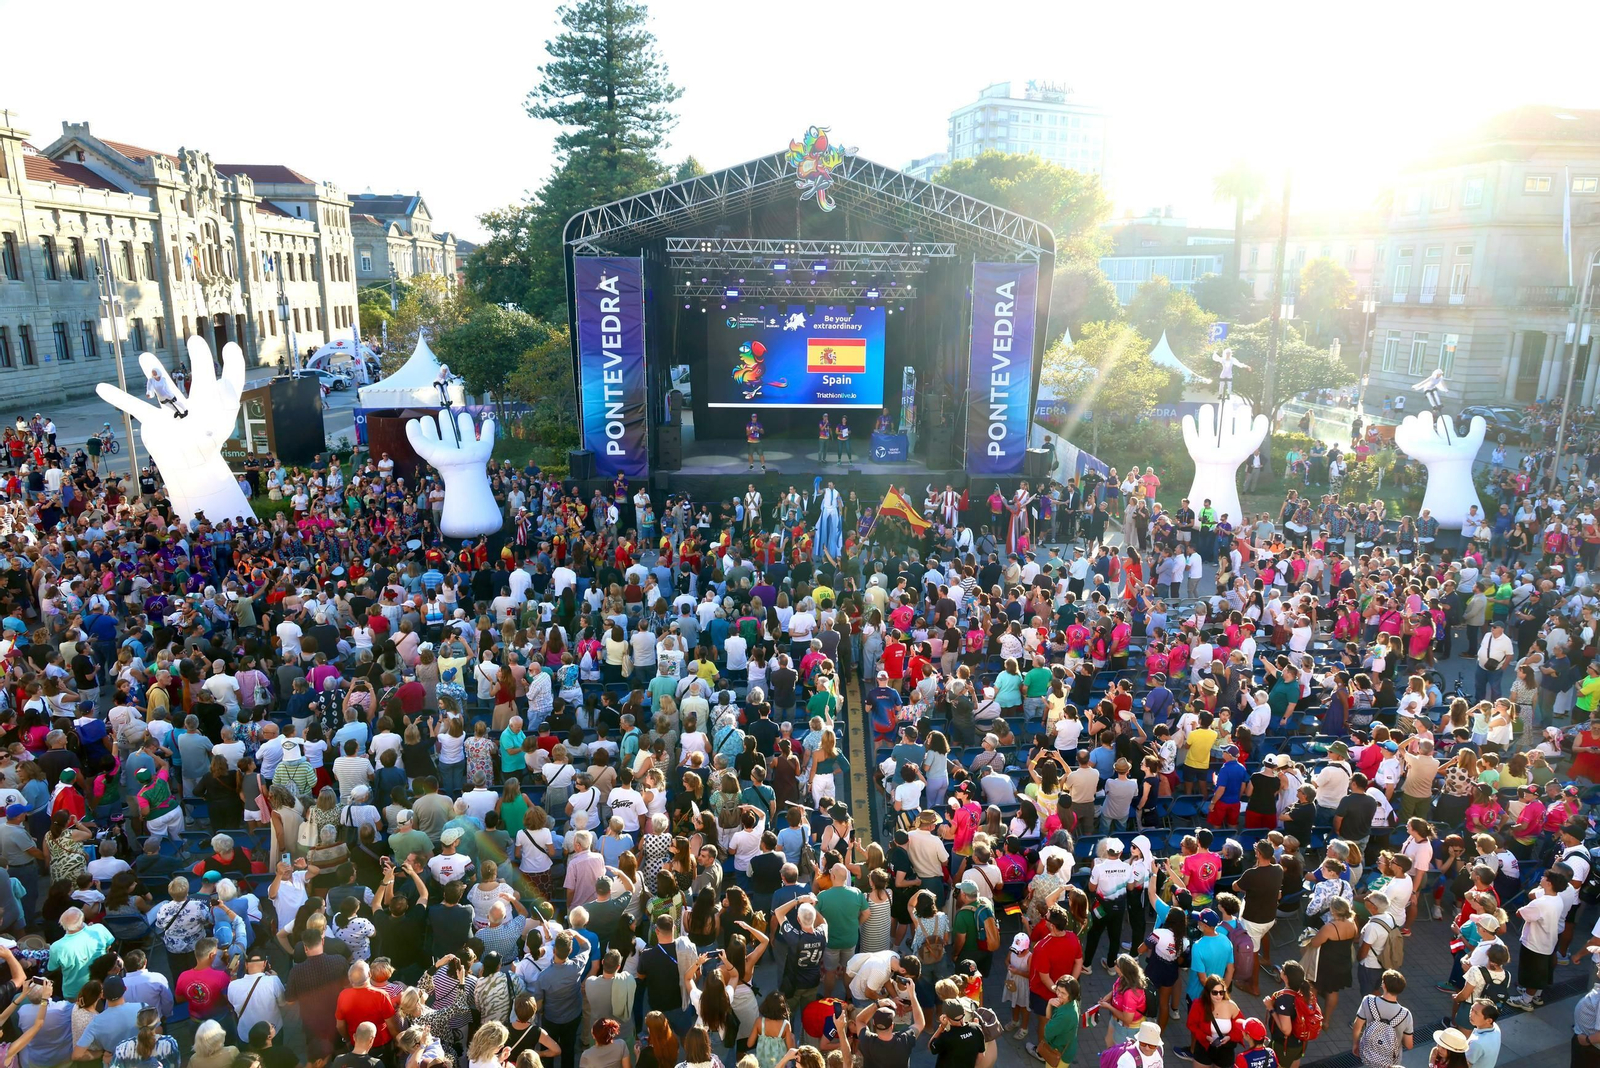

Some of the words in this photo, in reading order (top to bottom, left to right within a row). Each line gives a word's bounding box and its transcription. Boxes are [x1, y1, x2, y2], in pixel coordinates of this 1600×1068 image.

[813, 323, 862, 331] extraordinary
[600, 275, 626, 456] PONTEVEDRA
[987, 280, 1016, 457] PONTEVEDRA
[822, 375, 852, 386] Spain
[798, 949, 823, 967] 24
[959, 1032, 973, 1040] TEAM
